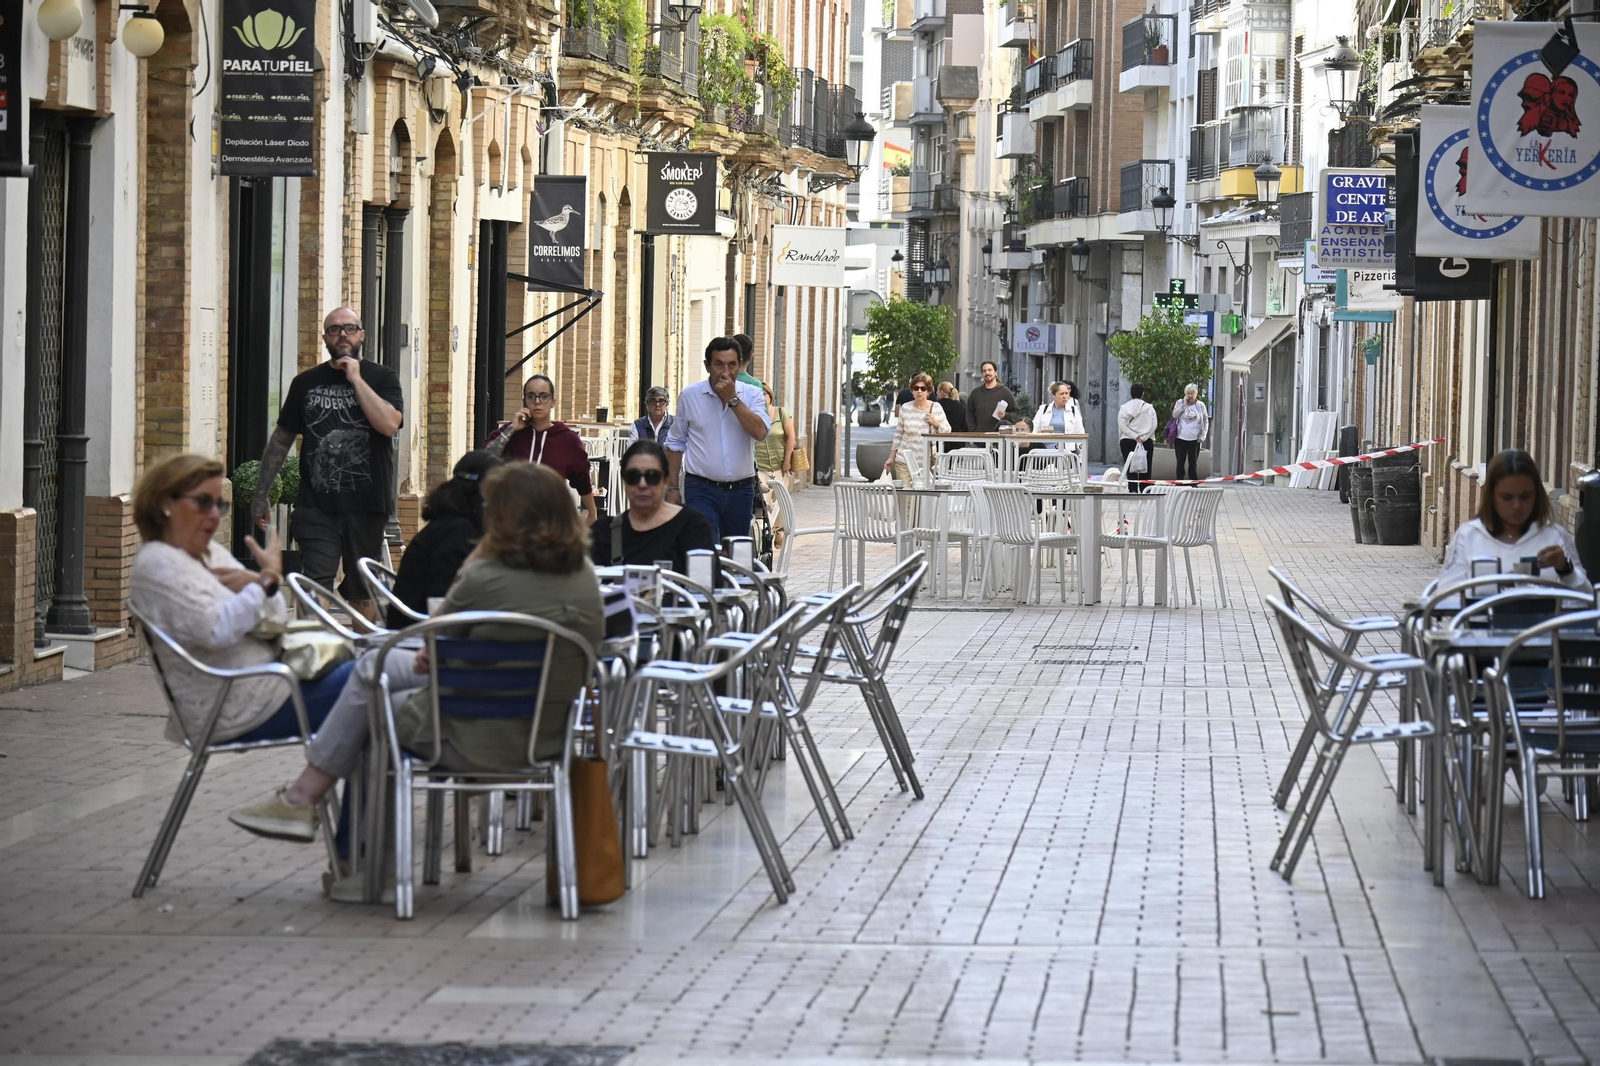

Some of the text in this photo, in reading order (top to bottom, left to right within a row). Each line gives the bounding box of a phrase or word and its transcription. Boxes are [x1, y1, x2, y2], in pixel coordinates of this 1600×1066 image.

[223, 59, 313, 72] PARATUPIEL
[225, 138, 263, 146] Depilación
[1336, 211, 1385, 223] DE AR
[533, 245, 580, 257] CORRELIMOS
[785, 248, 840, 262] Ramblado
[308, 394, 359, 410] SPIDER-M
